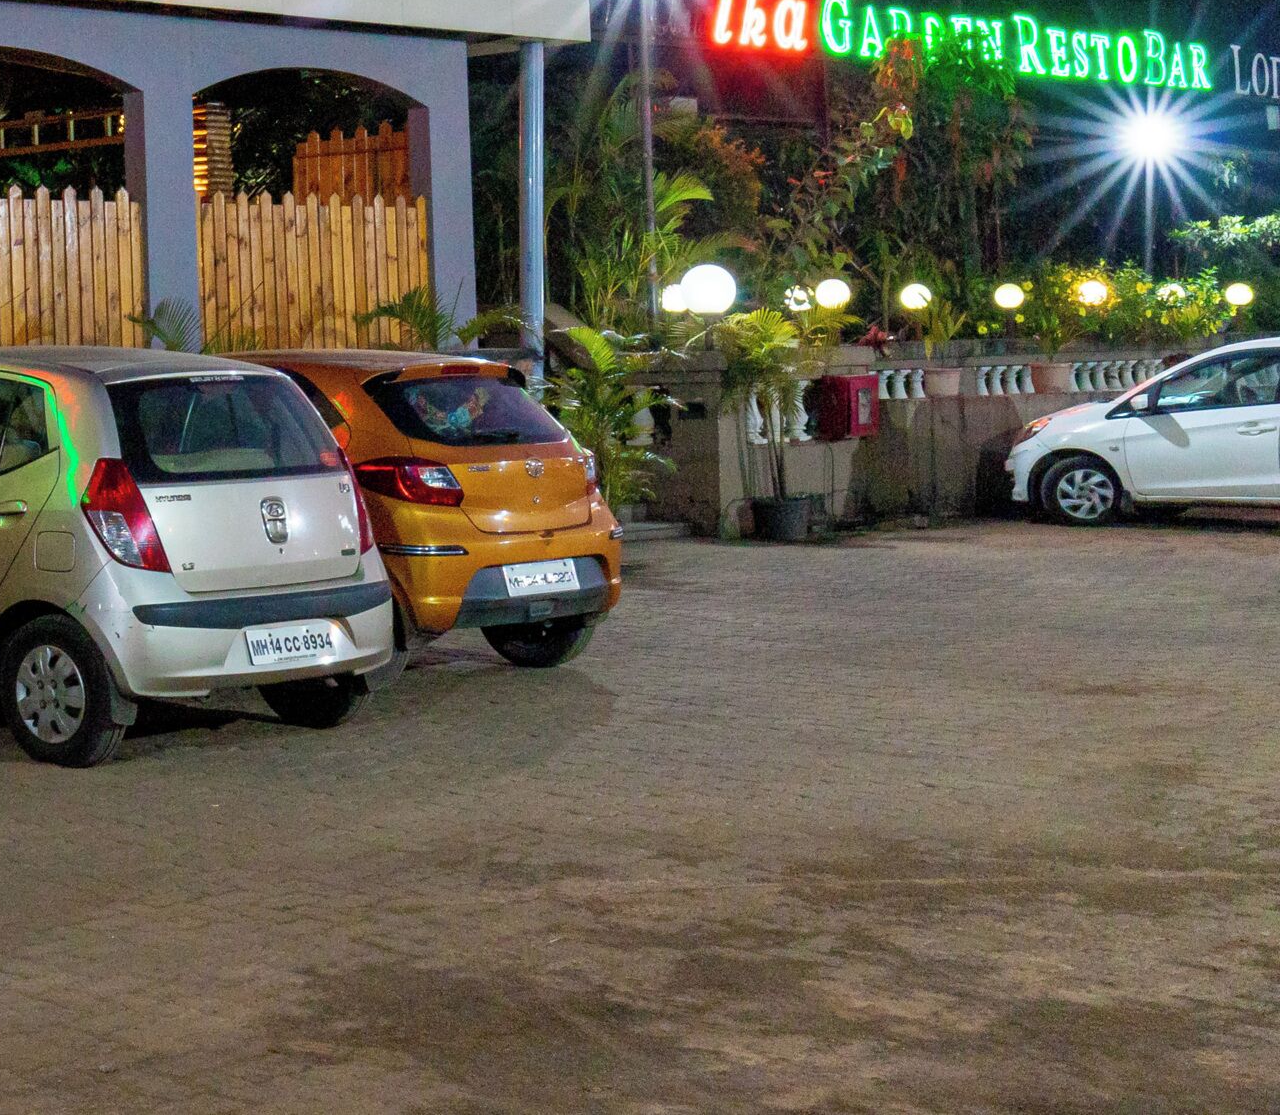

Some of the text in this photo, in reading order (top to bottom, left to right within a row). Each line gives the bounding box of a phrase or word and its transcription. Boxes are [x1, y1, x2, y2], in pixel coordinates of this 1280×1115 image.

[250, 632, 333, 656] MH 14 CC 8934
